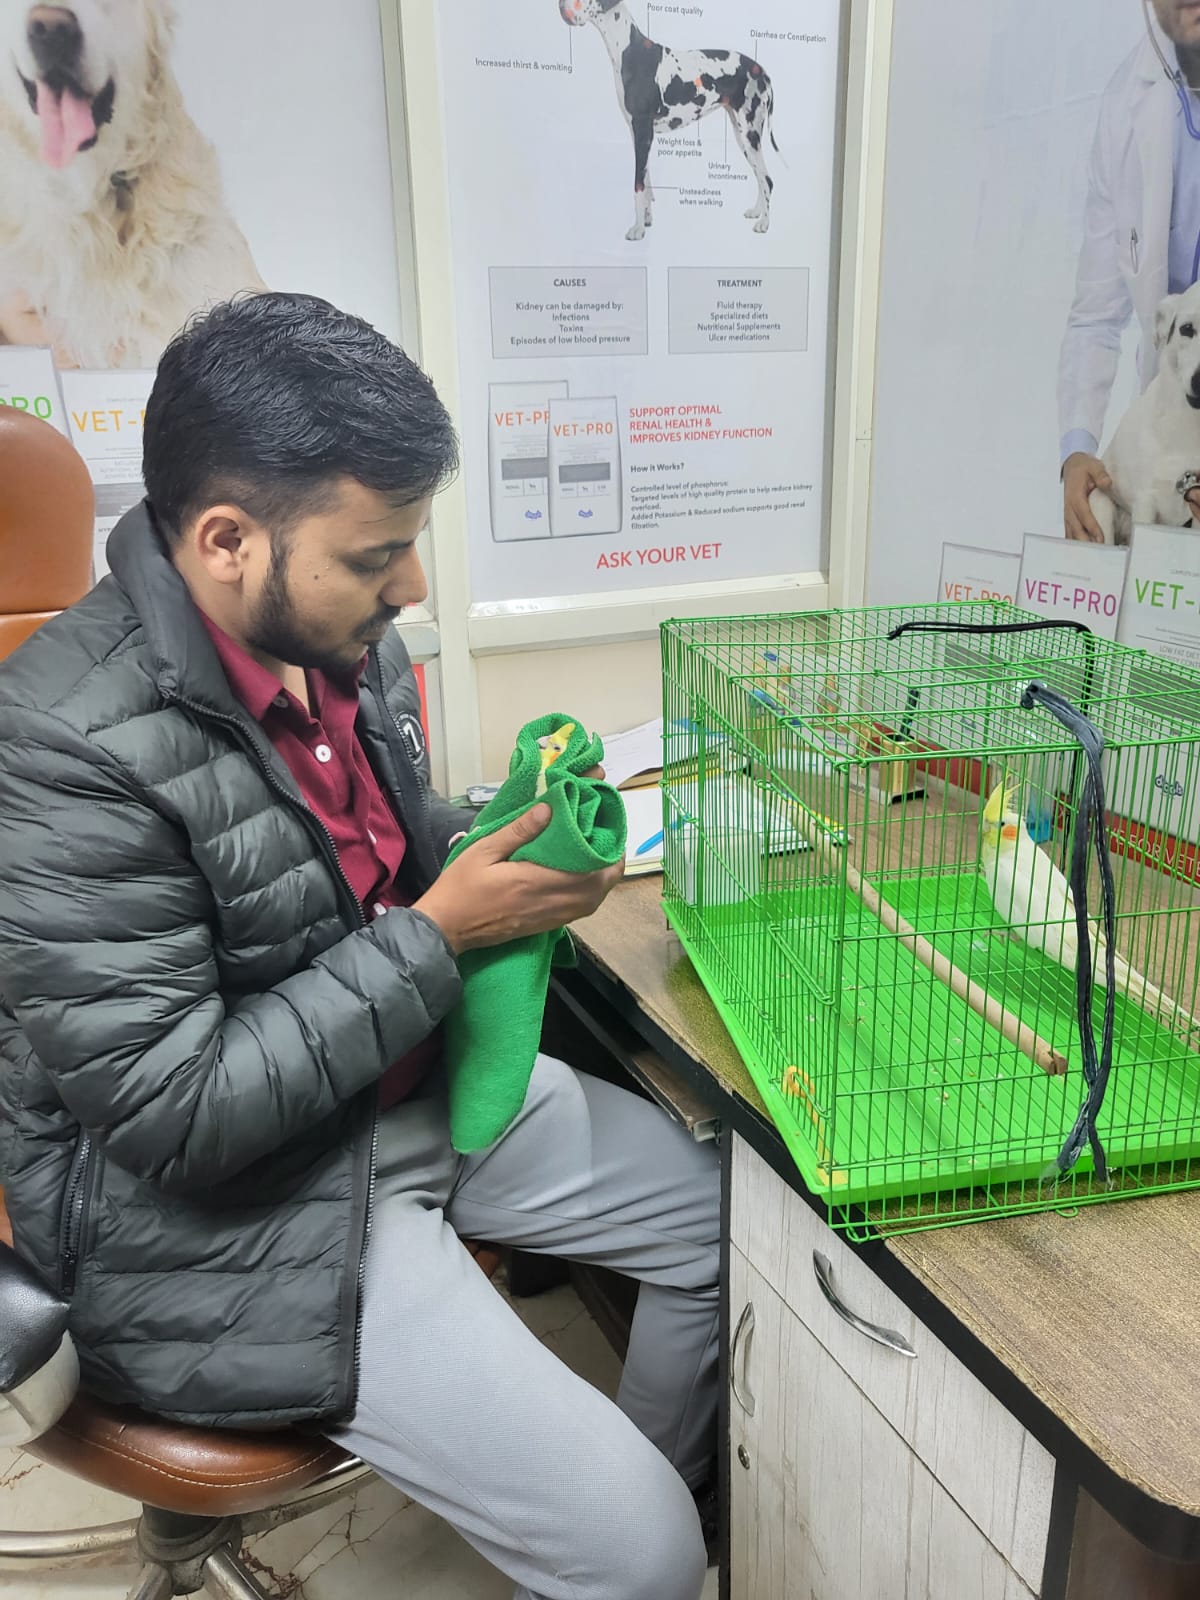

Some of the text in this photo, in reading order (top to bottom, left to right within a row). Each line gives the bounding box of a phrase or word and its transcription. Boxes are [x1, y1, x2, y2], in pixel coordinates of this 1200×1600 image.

[647, 3, 703, 16] Poor coat quality
[750, 30, 778, 39] Diarrhea
[787, 32, 827, 43] Constipation
[475, 58, 573, 73] Increased thirst & vomiting
[657, 138, 681, 147] Weight
[657, 149, 702, 158] poor appetite
[708, 162, 731, 171] Urinary
[708, 173, 748, 181] incontinence
[679, 188, 721, 196] Unsteadiness
[698, 199, 723, 207] walking
[554, 278, 587, 288] CAUSES
[717, 280, 763, 288] TREATMENT
[516, 302, 544, 312] Kidney
[561, 302, 572, 310] be
[573, 301, 610, 312] damaged
[612, 302, 624, 312] by:
[716, 301, 763, 311] Fluid therapy
[552, 313, 590, 322] Infections
[710, 312, 768, 321] Specialized diets
[559, 324, 584, 332] Toxins
[697, 322, 781, 332] Nutritional Supplements
[510, 335, 631, 346] Episodes of low blood pressure
[708, 333, 770, 342] Ulcer medications
[629, 404, 722, 418] SUPPORT OPTIMAL
[629, 417, 712, 431] RENAL HEALTH &
[553, 422, 613, 437] VET-PRO
[630, 427, 773, 444] IMPROVES KIDNEY FUNCTION
[630, 462, 685, 473] How it Works?
[631, 484, 665, 493] Controlled
[631, 494, 659, 503] Targeted
[689, 491, 702, 499] high
[704, 490, 724, 498] quality
[726, 488, 748, 496] protein
[756, 485, 770, 494] help
[793, 483, 813, 491] kidney
[631, 503, 662, 512] overload.
[631, 512, 653, 520] Added
[654, 511, 686, 519] Potassium
[694, 507, 721, 515] Reduced
[723, 506, 745, 514] sodium
[746, 504, 772, 512] supports
[773, 501, 789, 511] good
[596, 543, 722, 569] ASK YOUR VET
[1025, 578, 1116, 617] VET-PRO
[1136, 578, 1200, 615] VET-
